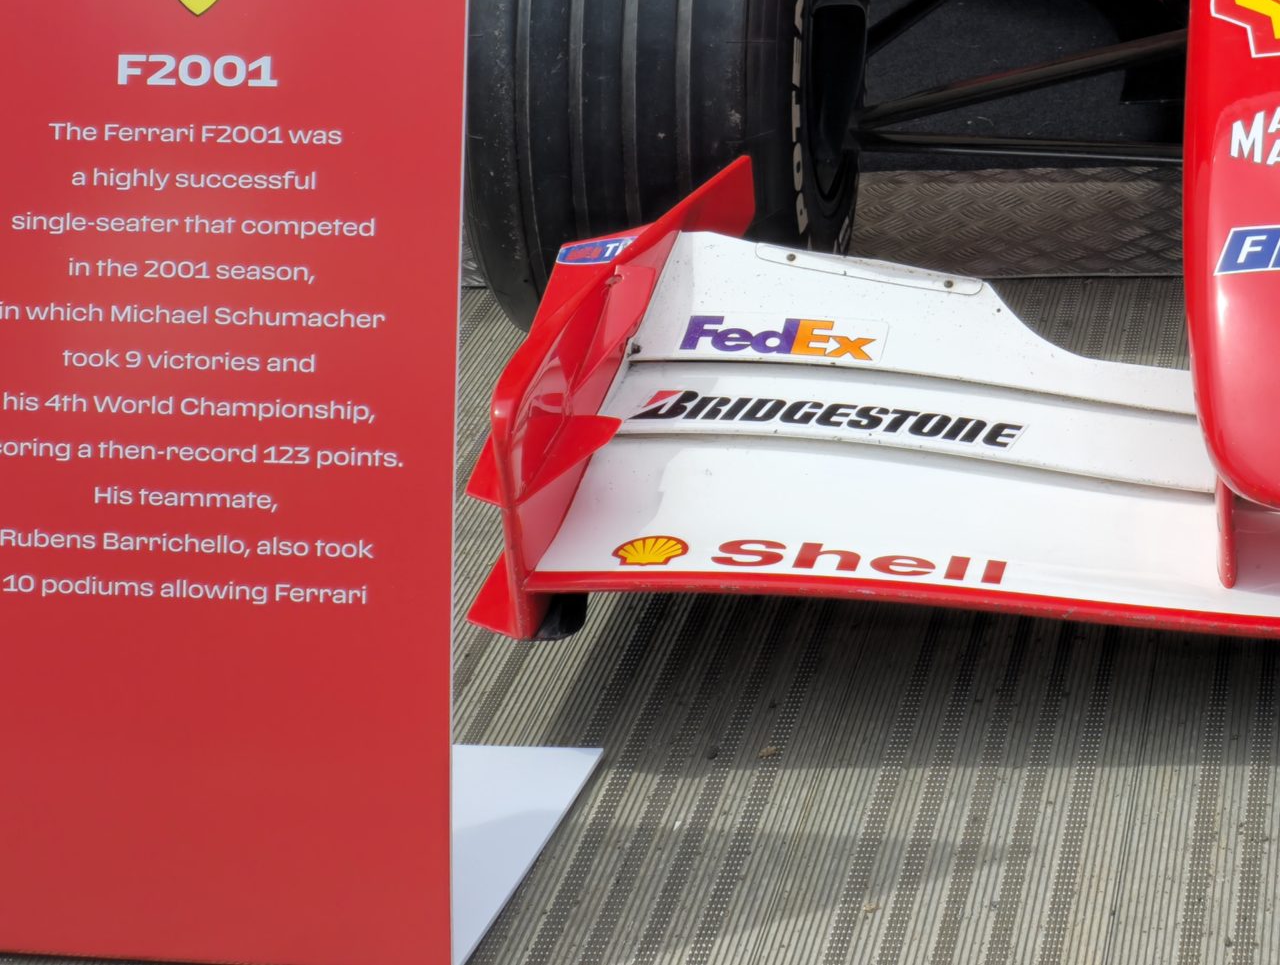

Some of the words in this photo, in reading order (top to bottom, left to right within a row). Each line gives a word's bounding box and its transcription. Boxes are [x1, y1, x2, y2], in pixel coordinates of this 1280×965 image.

[117, 53, 279, 88] F2001
[48, 121, 98, 141] The
[104, 123, 195, 143] Ferrari
[201, 125, 284, 144] F2001
[287, 129, 343, 145] was
[71, 171, 87, 186] a
[93, 167, 171, 192] highly
[175, 170, 317, 190] successful
[11, 211, 180, 235] single-seater
[183, 214, 237, 234] that
[240, 217, 376, 240] competed
[604, 239, 632, 257] TI
[68, 257, 91, 277] in
[95, 258, 139, 278] the
[143, 260, 211, 279] 2001
[215, 264, 315, 285] season,
[0, 301, 20, 320] in
[25, 302, 104, 322] which
[110, 304, 208, 325] Michael
[214, 306, 386, 329] Schumacher
[679, 315, 873, 361] FedEx
[62, 348, 120, 368] took
[124, 350, 143, 369] 9
[146, 350, 261, 372] victories
[266, 353, 316, 373] and
[3, 391, 40, 412] his
[44, 393, 87, 413] 4th
[93, 395, 174, 415] World
[180, 396, 375, 424] Championship,
[628, 390, 1024, 448] BRIDGESTONE
[0, 438, 71, 462] oring
[77, 443, 92, 459] a
[97, 440, 257, 463] then-record
[263, 445, 311, 465] 123
[316, 447, 404, 469] points.
[94, 485, 134, 505] His
[138, 488, 278, 513] teammate,
[0, 528, 97, 550] Rubens
[103, 532, 251, 558] Barrichello,
[256, 536, 310, 557] also
[314, 539, 374, 559] took
[711, 539, 1007, 584] Shell
[2, 574, 35, 593] 10
[41, 576, 154, 597] podiums
[160, 579, 268, 605] allowing
[275, 583, 367, 605] Ferrari
